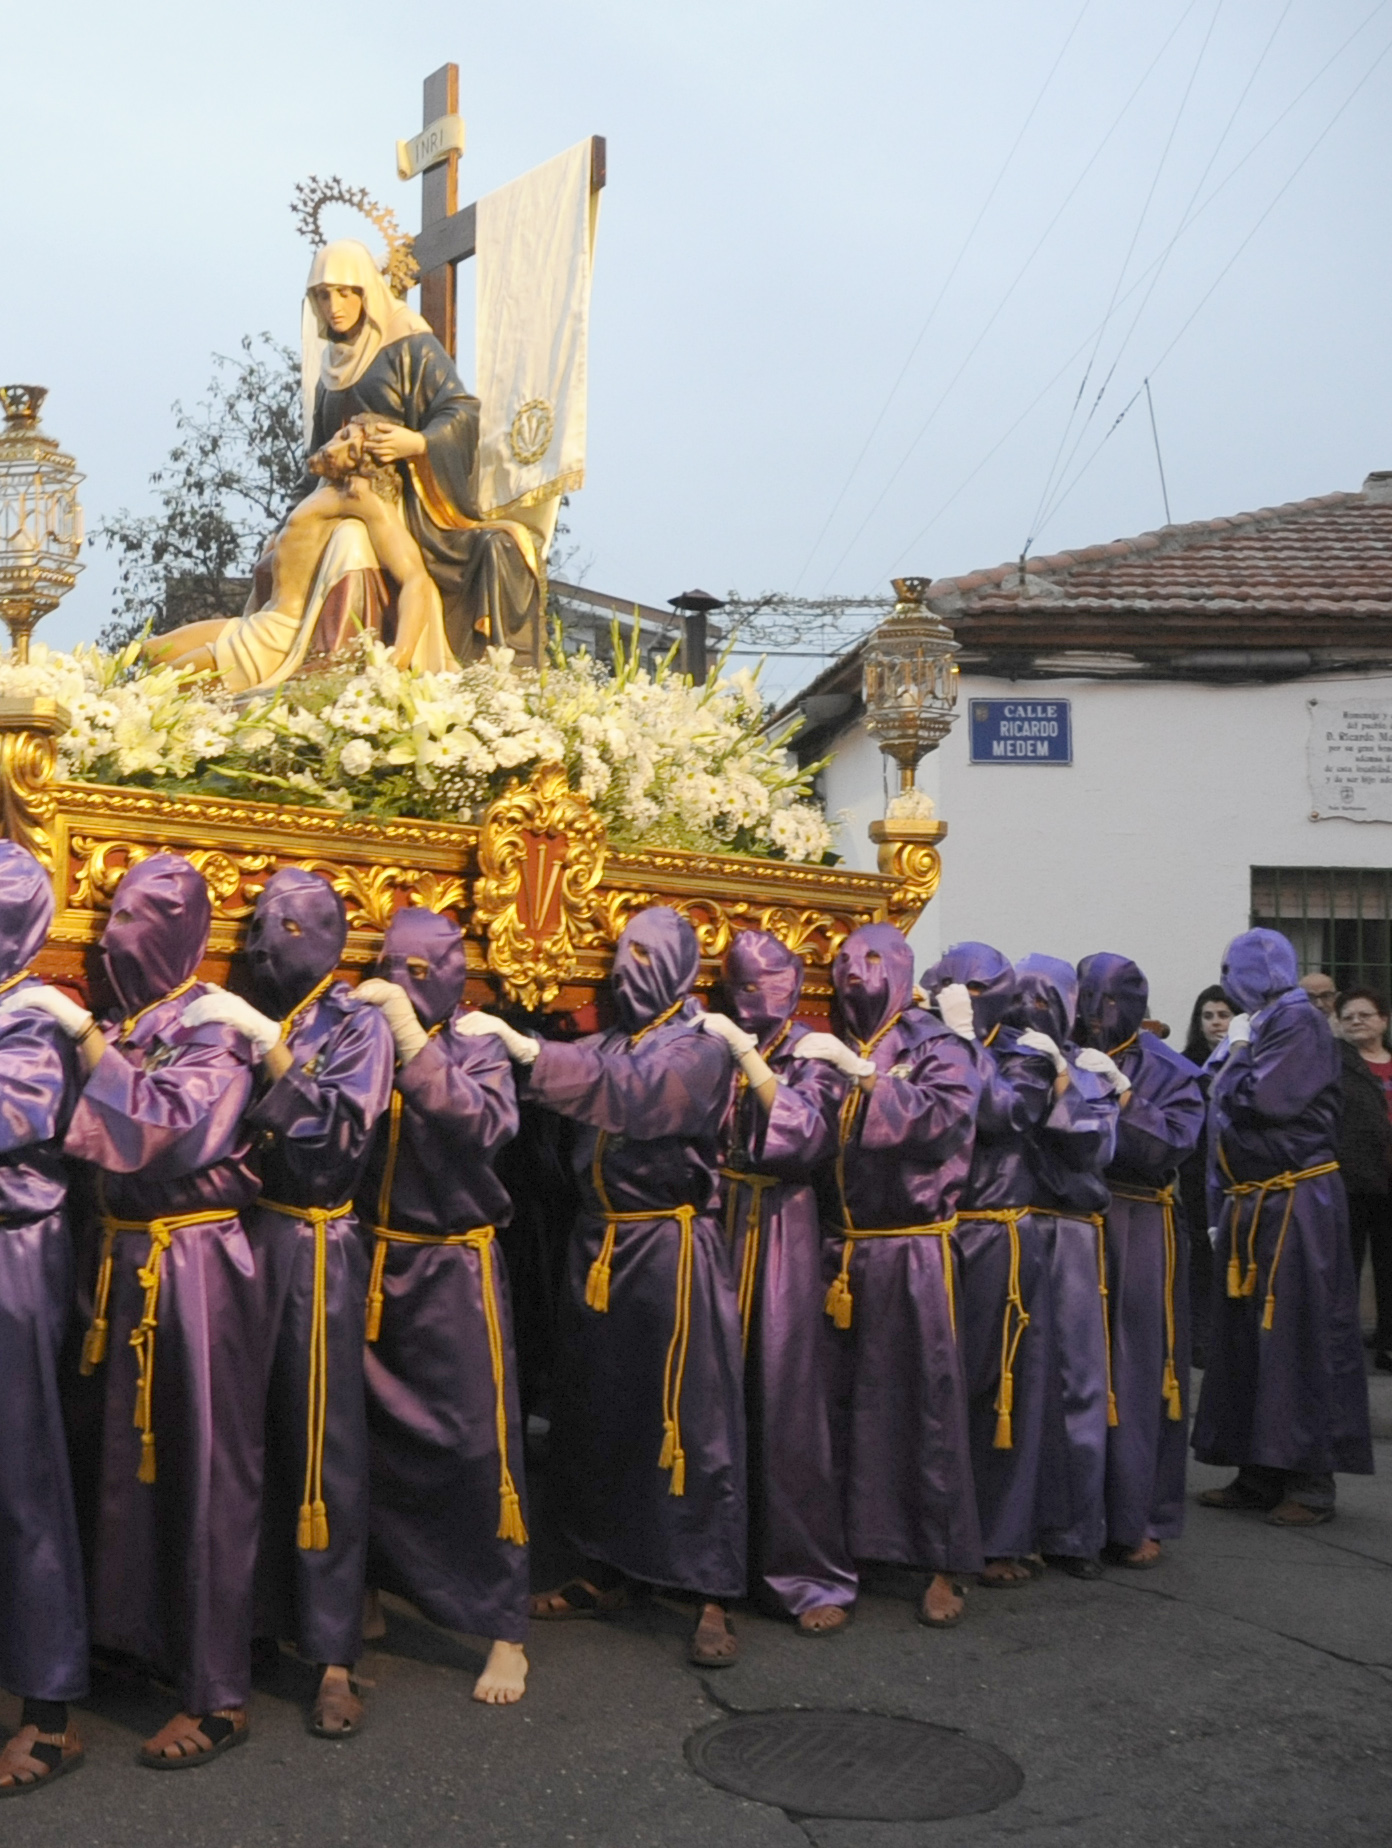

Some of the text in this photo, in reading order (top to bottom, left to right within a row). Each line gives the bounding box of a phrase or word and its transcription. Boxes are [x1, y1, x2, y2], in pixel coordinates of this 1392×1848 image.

[416, 129, 443, 163] INRI
[1004, 705, 1057, 718] CALLE
[1000, 720, 1058, 737] RICARDO
[993, 740, 1049, 756] MEDEM
